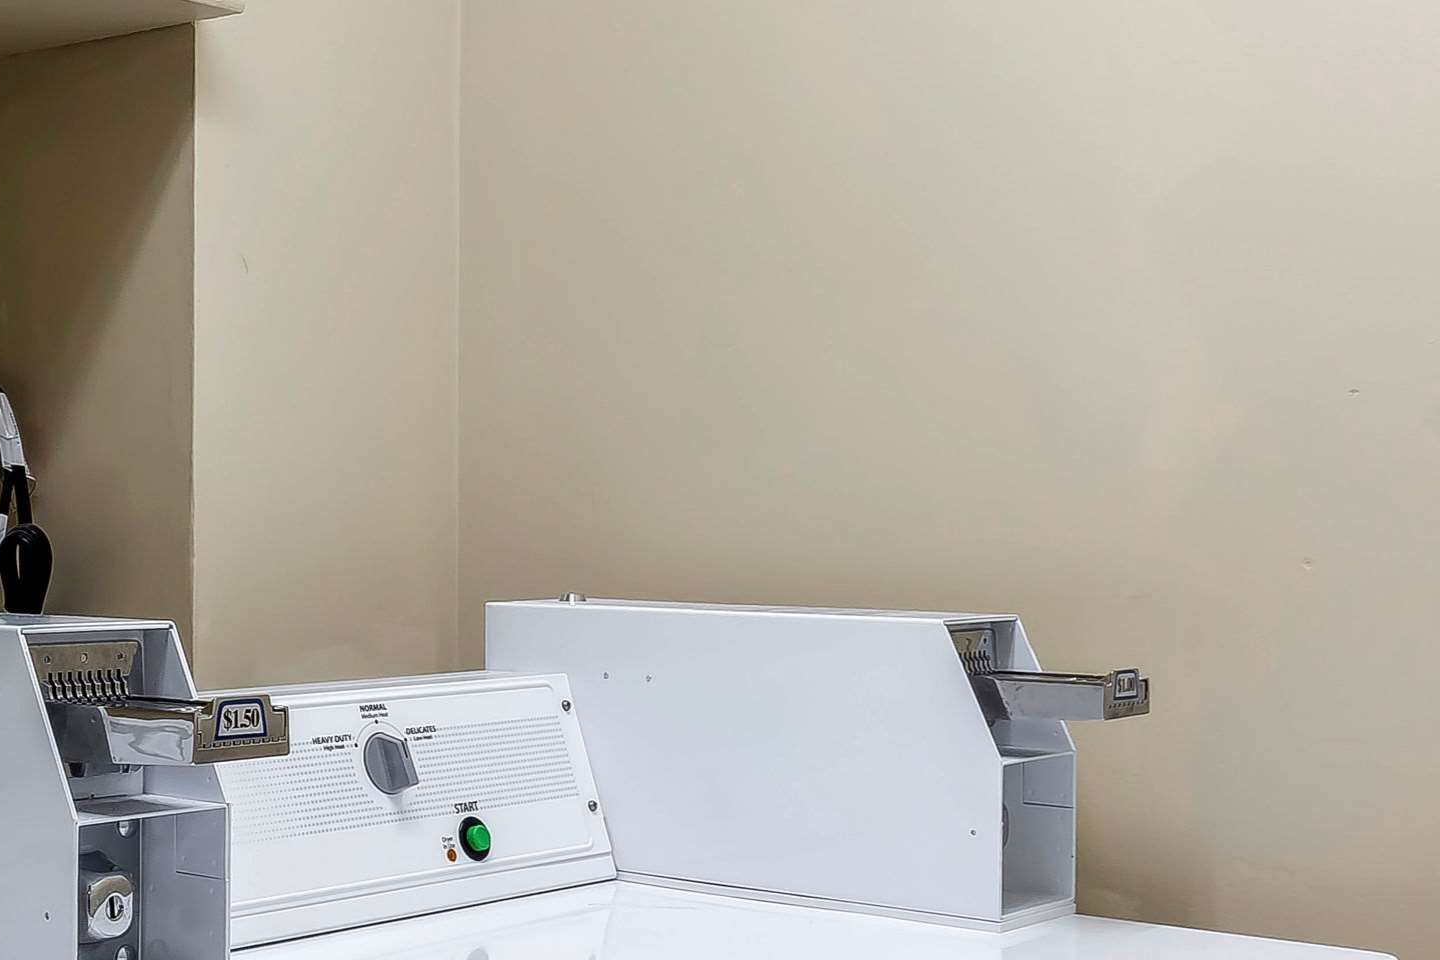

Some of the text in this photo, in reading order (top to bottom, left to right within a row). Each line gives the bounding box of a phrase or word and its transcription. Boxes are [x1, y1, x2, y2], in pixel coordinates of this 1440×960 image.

[359, 704, 387, 712] NORMAL
[223, 708, 260, 731] $1.50
[405, 725, 436, 735] DELICATES
[312, 734, 352, 745] HEAVY DUTY
[454, 800, 479, 814] START
